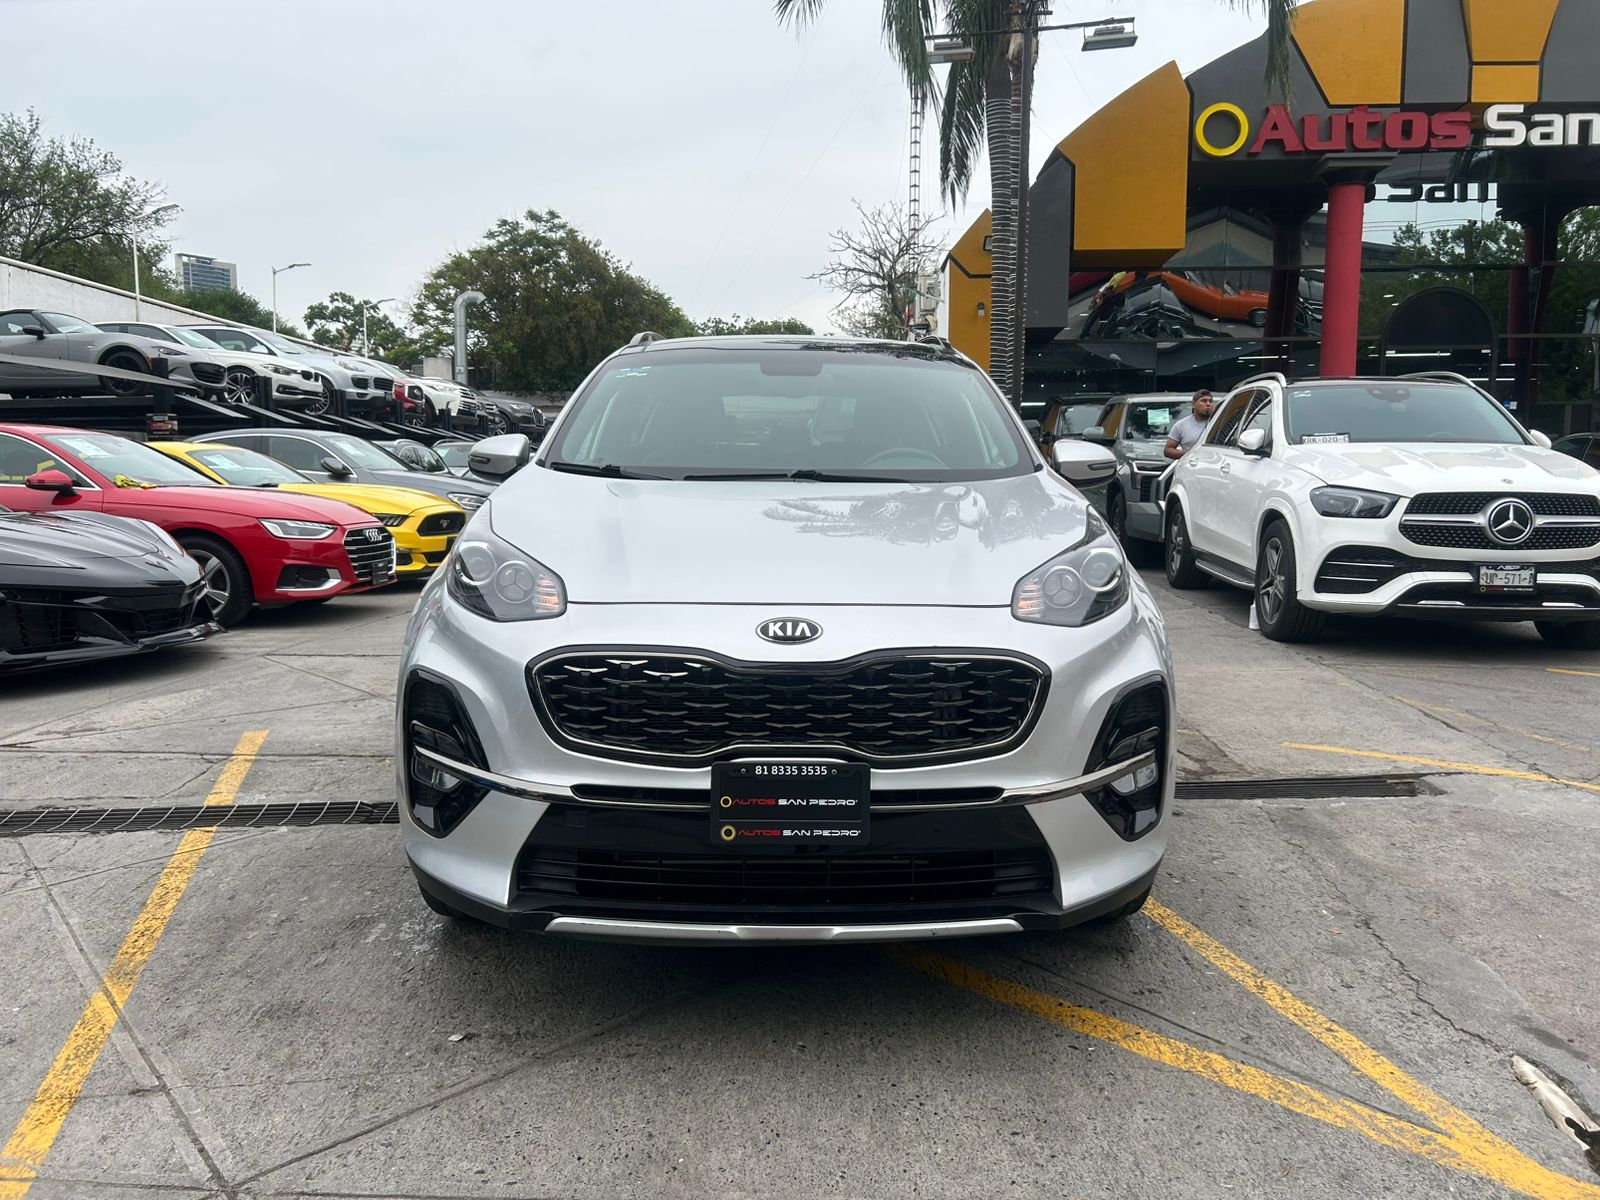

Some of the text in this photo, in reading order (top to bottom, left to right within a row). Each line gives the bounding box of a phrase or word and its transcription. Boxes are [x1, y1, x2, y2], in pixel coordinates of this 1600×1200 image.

[1247, 104, 1600, 154] Autos San
[768, 622, 811, 637] KIA
[755, 765, 828, 775] 81 8335 3535
